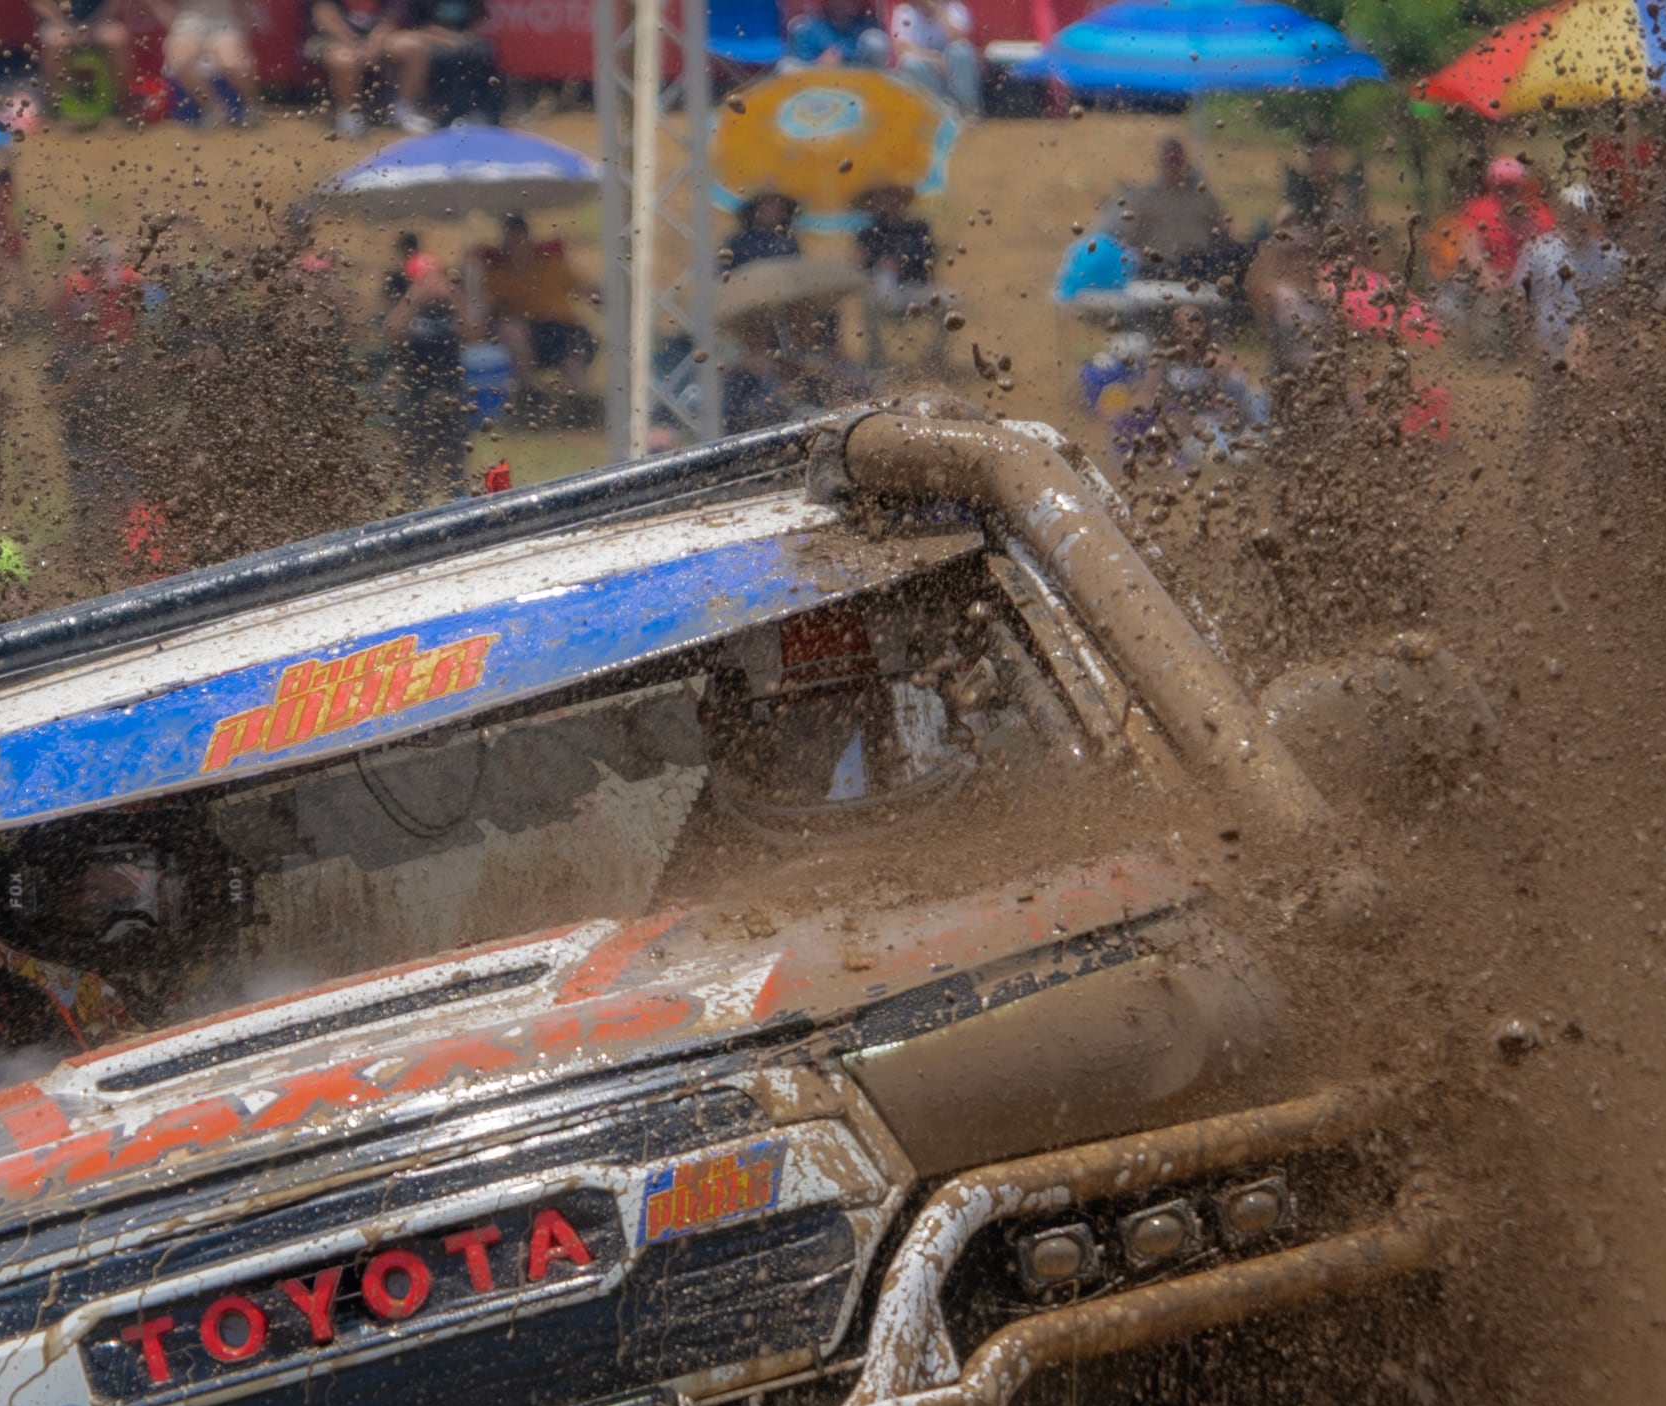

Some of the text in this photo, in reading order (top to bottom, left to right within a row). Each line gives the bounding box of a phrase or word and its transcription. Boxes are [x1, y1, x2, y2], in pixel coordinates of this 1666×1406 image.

[200, 633, 501, 773] POWER
[9, 872, 23, 908] FOX
[121, 1208, 594, 1383] TOYOTA
